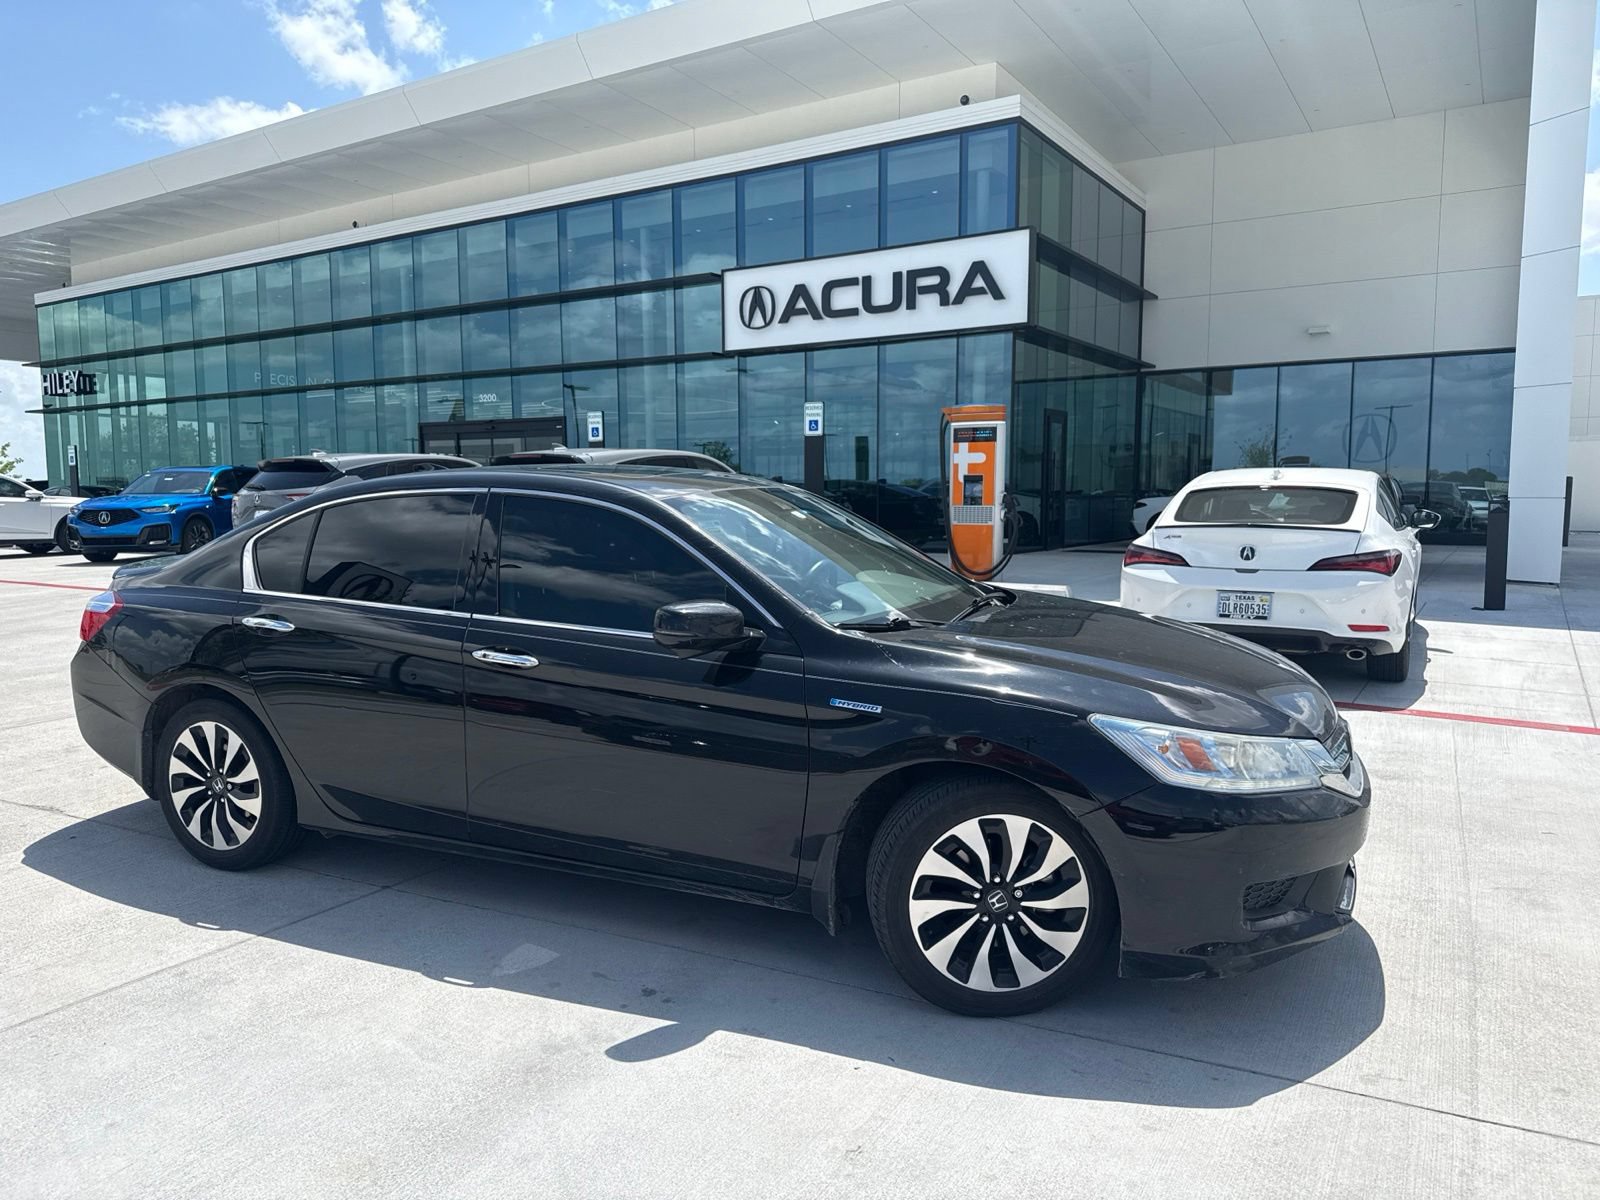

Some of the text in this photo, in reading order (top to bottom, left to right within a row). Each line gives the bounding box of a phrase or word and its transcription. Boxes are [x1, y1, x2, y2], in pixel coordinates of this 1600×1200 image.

[778, 260, 1006, 325] ACURA
[41, 370, 80, 395] HILEY
[479, 393, 497, 402] 3200
[1221, 601, 1267, 615] DLR60535
[837, 701, 879, 711] HYBRID
